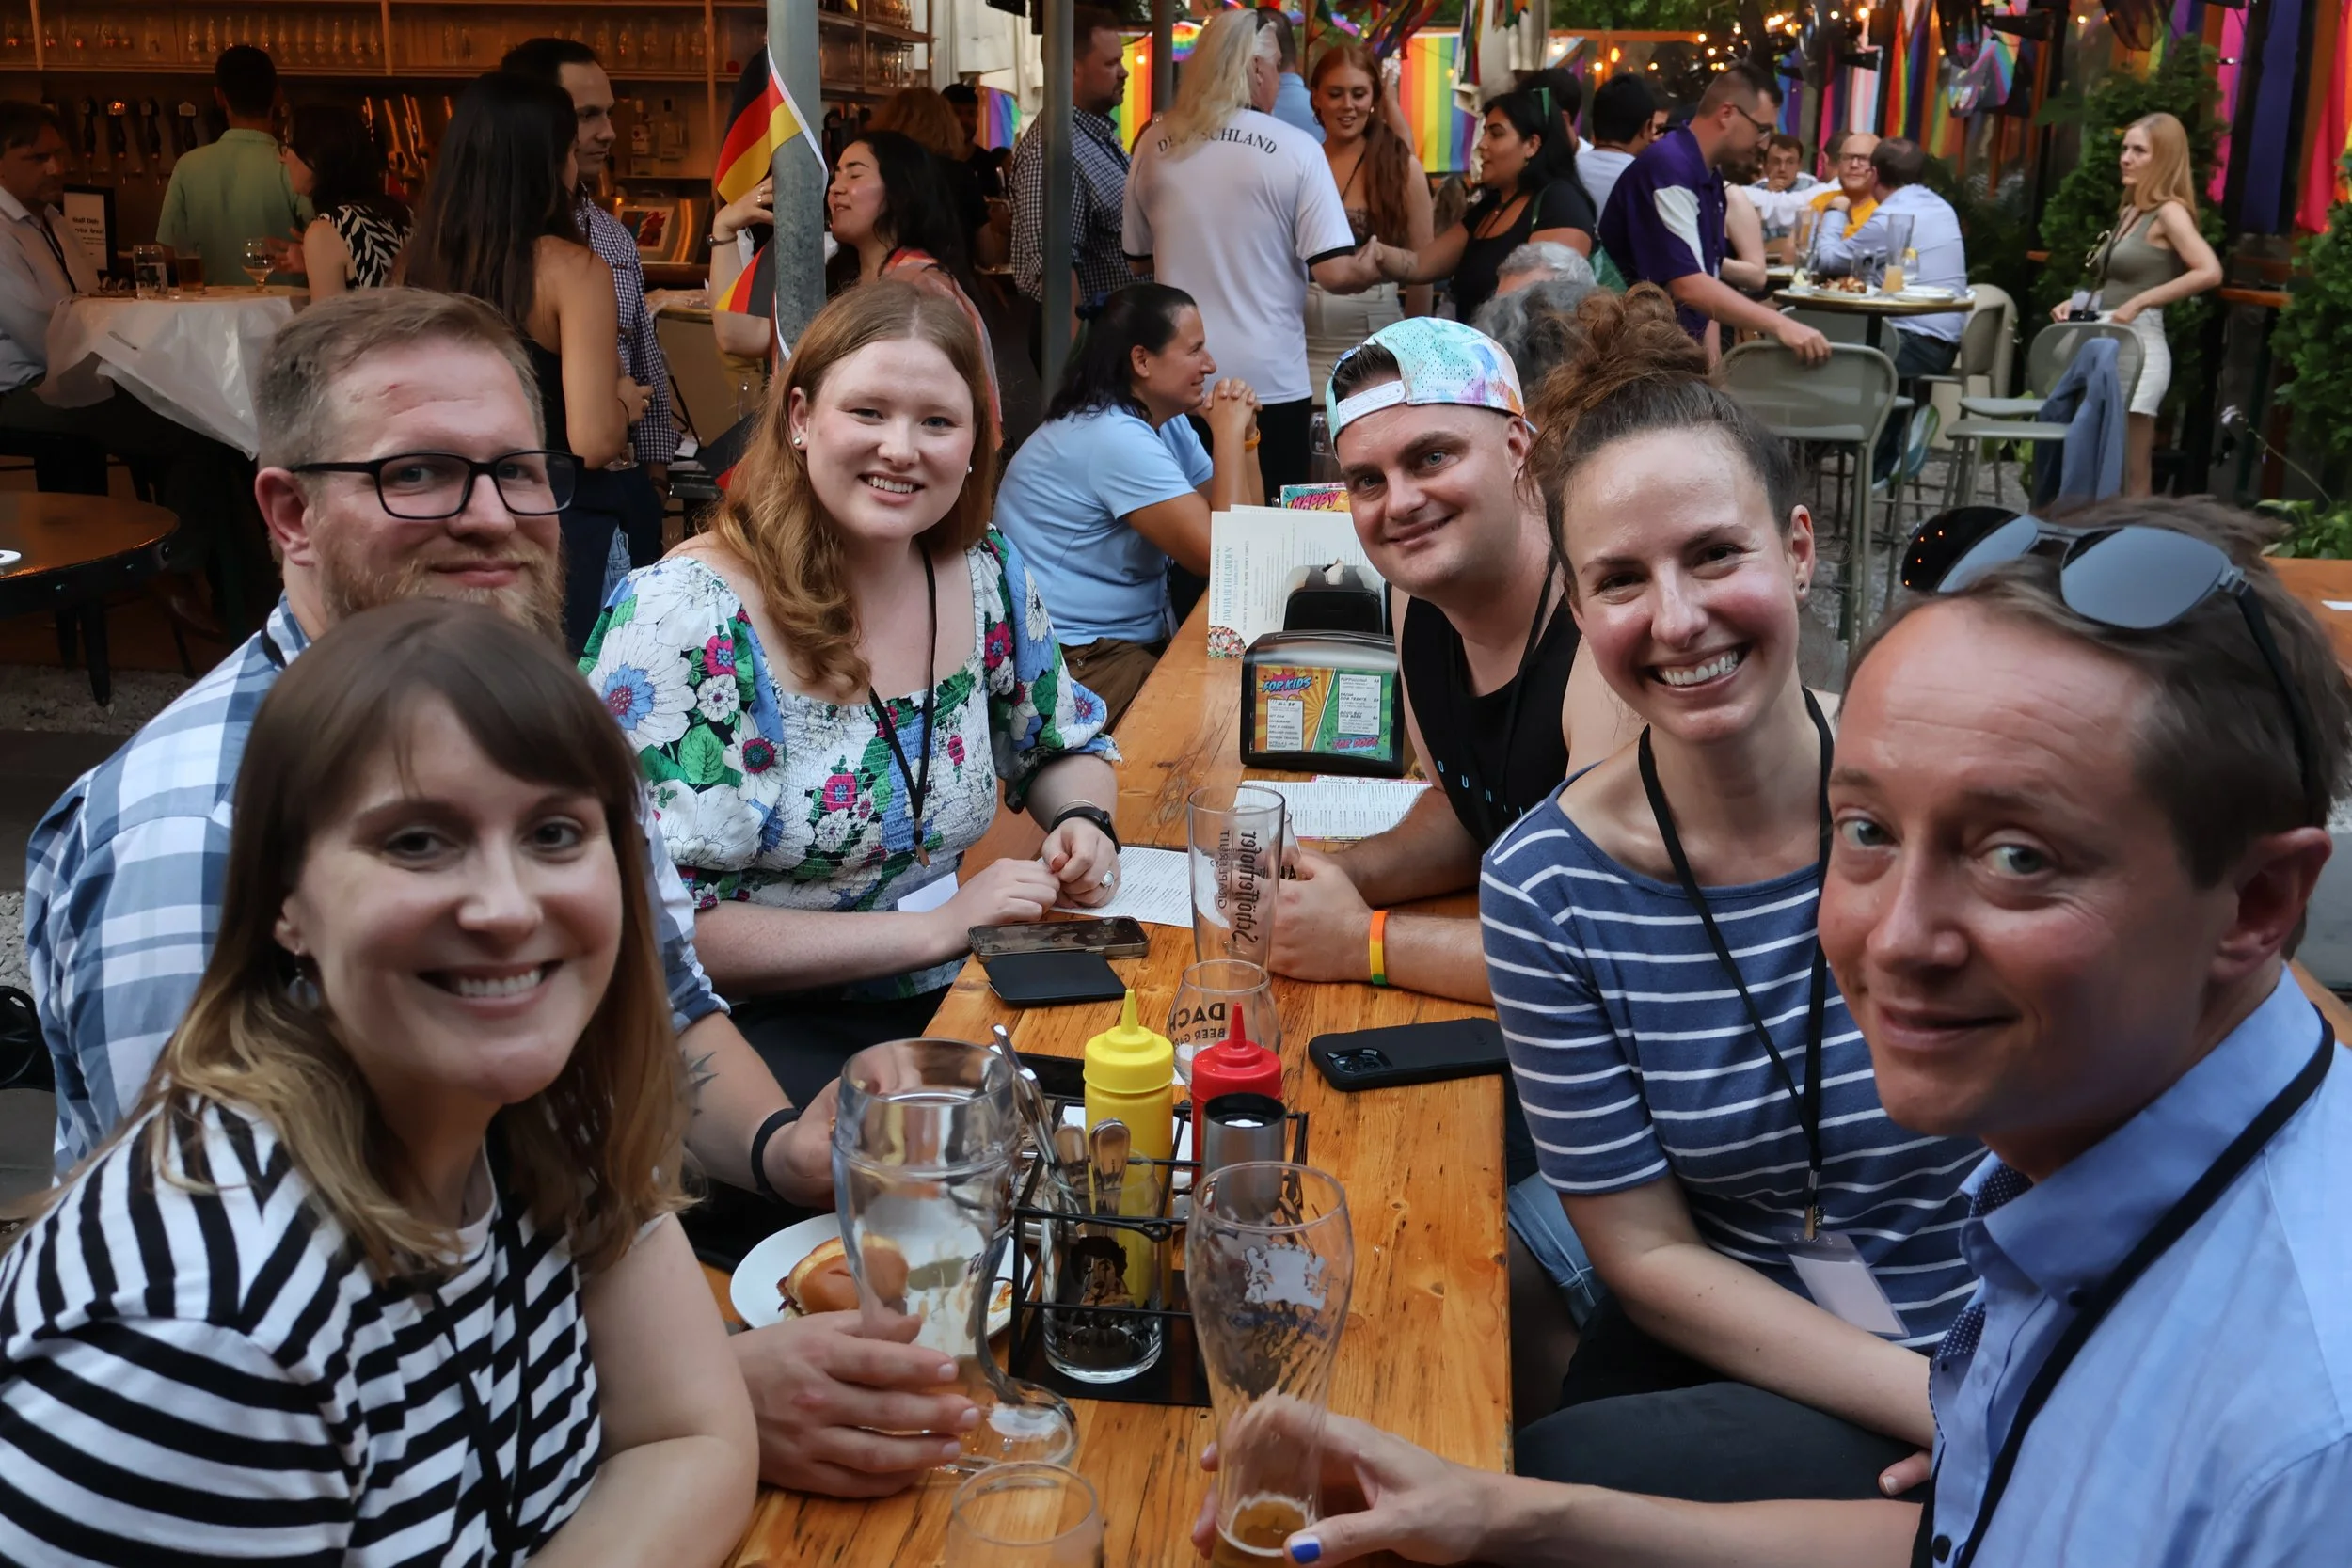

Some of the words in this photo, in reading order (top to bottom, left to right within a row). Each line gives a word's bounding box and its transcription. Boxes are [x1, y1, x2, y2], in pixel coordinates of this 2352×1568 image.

[1291, 490, 1341, 510] HAPPY
[1262, 680, 1284, 694] FOR
[1284, 675, 1313, 691] KIDS
[1333, 737, 1351, 750] FOR
[1353, 736, 1379, 749] DOGS
